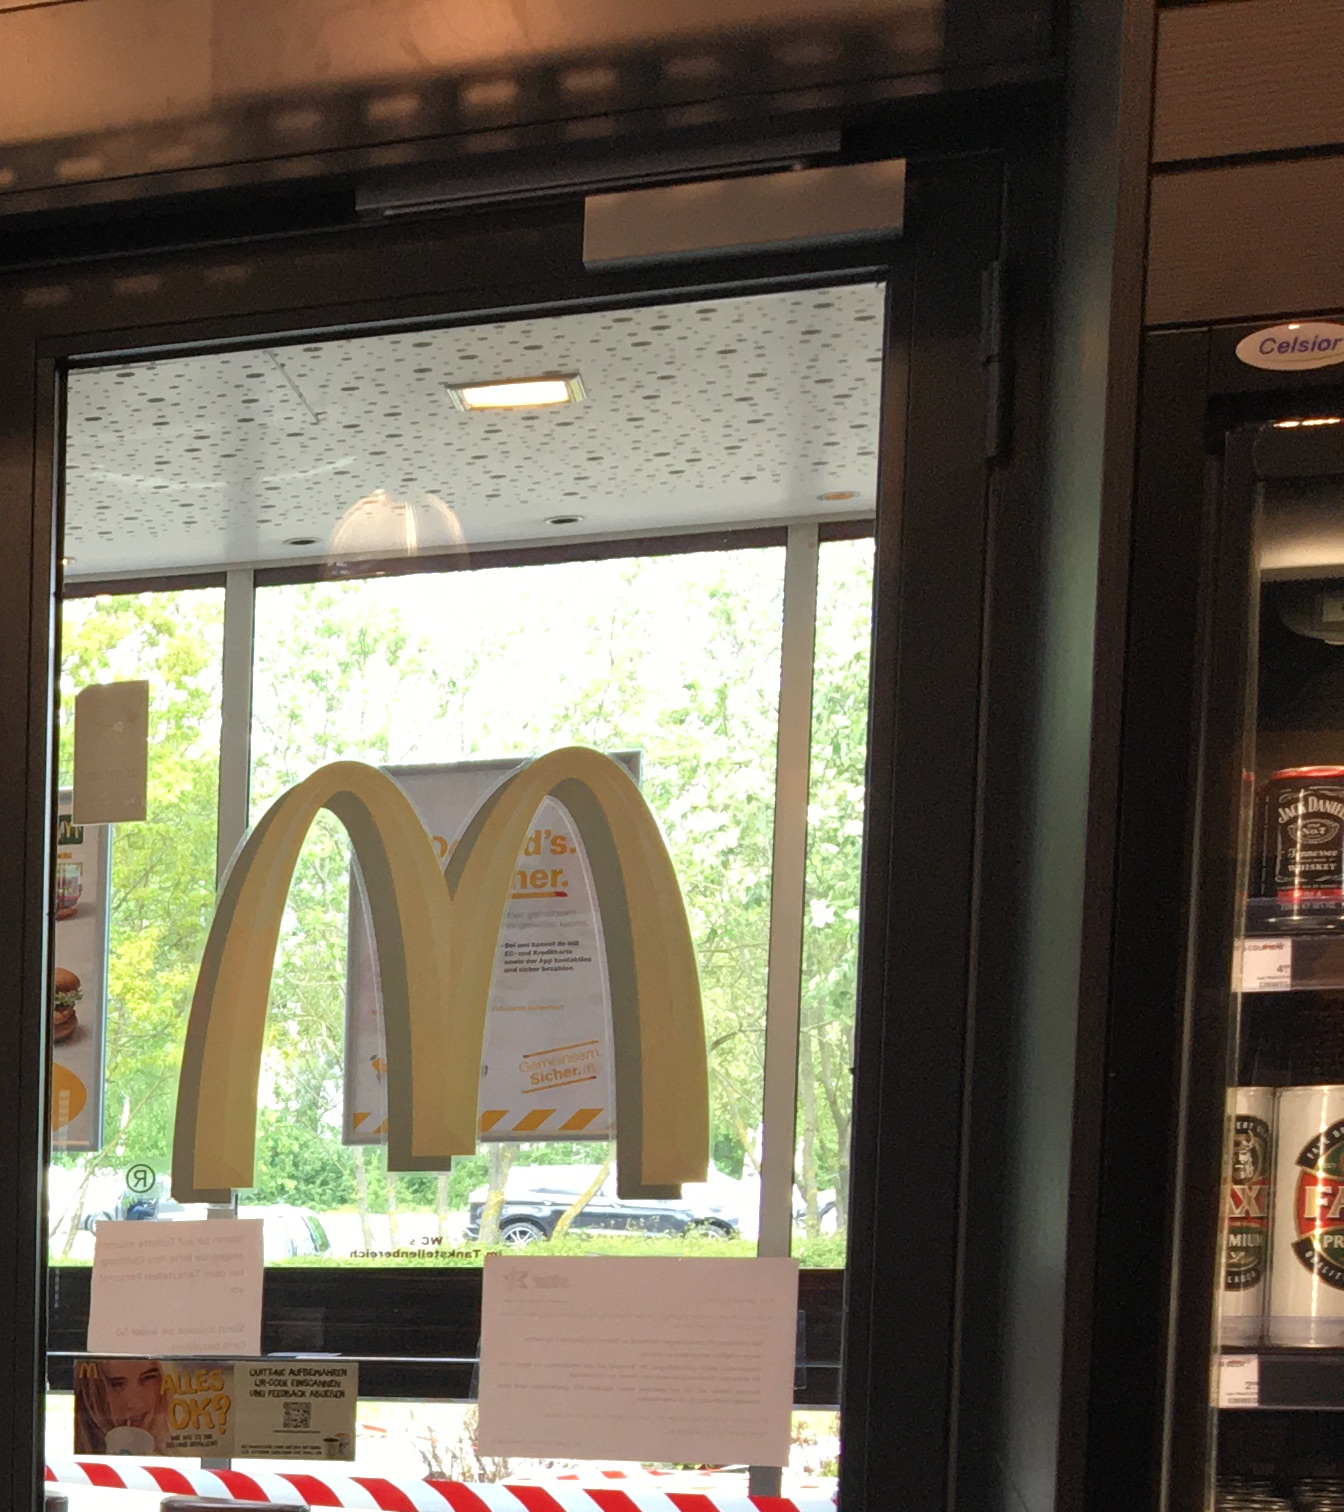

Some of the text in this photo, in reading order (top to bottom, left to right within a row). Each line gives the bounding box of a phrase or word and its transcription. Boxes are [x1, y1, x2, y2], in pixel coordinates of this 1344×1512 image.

[1259, 335, 1343, 355] Celsior
[1278, 801, 1306, 823] JACK
[520, 1049, 600, 1073] Gemeinsam
[530, 1066, 581, 1085] Sicher.
[162, 1369, 224, 1395] ALLES
[169, 1394, 231, 1435] OK?
